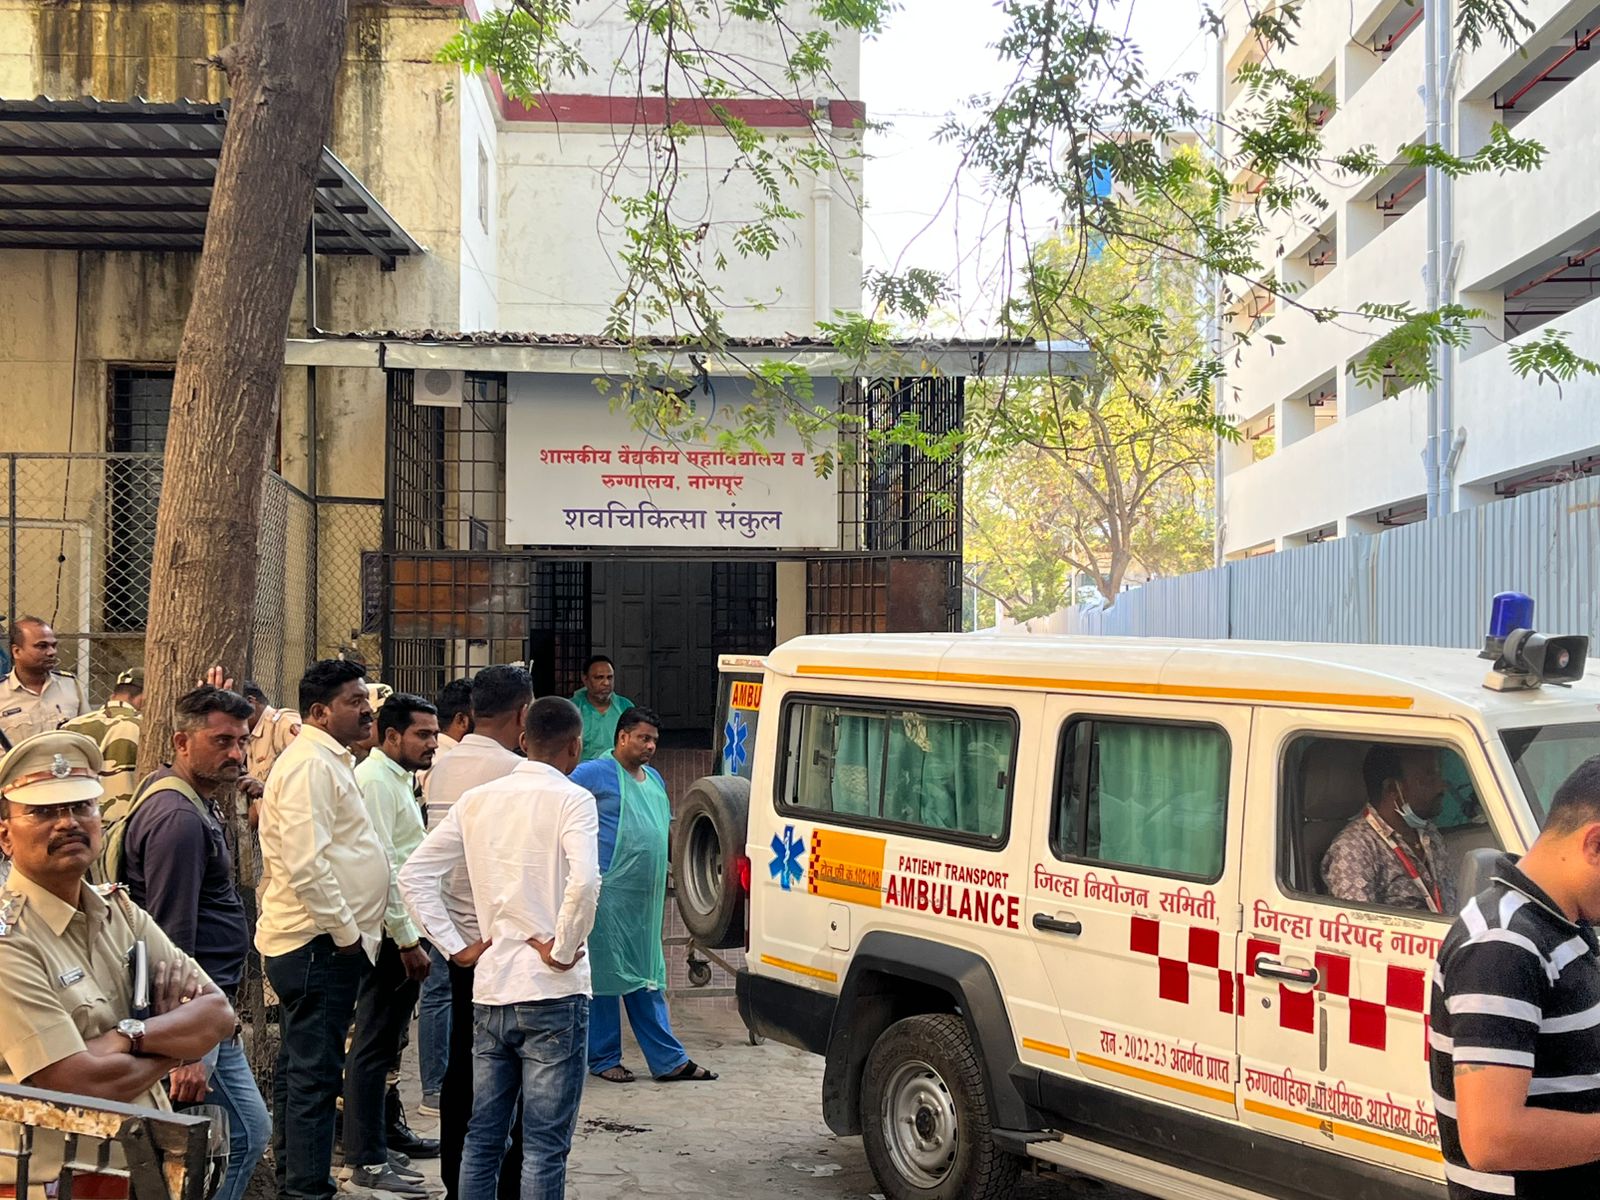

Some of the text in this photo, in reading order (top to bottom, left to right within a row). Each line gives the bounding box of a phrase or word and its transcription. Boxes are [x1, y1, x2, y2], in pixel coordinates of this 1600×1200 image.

[540, 445, 805, 468] शासकीय वैद्यकीय महाविद्यालय व
[602, 474, 744, 496] रुग्णालय, नागपूर
[562, 501, 782, 538] शवचिकित्सा संकुल
[732, 683, 762, 708] AMBU
[899, 856, 1009, 889] PATIENT TRANSPORT
[1034, 864, 1079, 897] जिल्हा
[1084, 872, 1149, 908] नियोजन
[886, 874, 1019, 930] AMBULANCE
[1253, 899, 1443, 959] जिल्हा परिषद नाग
[1100, 1030, 1116, 1055] सन
[1124, 1034, 1167, 1067] 2022-23
[1170, 1039, 1204, 1077] अंतर्गत
[1206, 1056, 1230, 1084] प्राप्त
[1245, 1067, 1311, 1107] रुग्णवाहिका
[1366, 1092, 1411, 1133] आरोग्य
